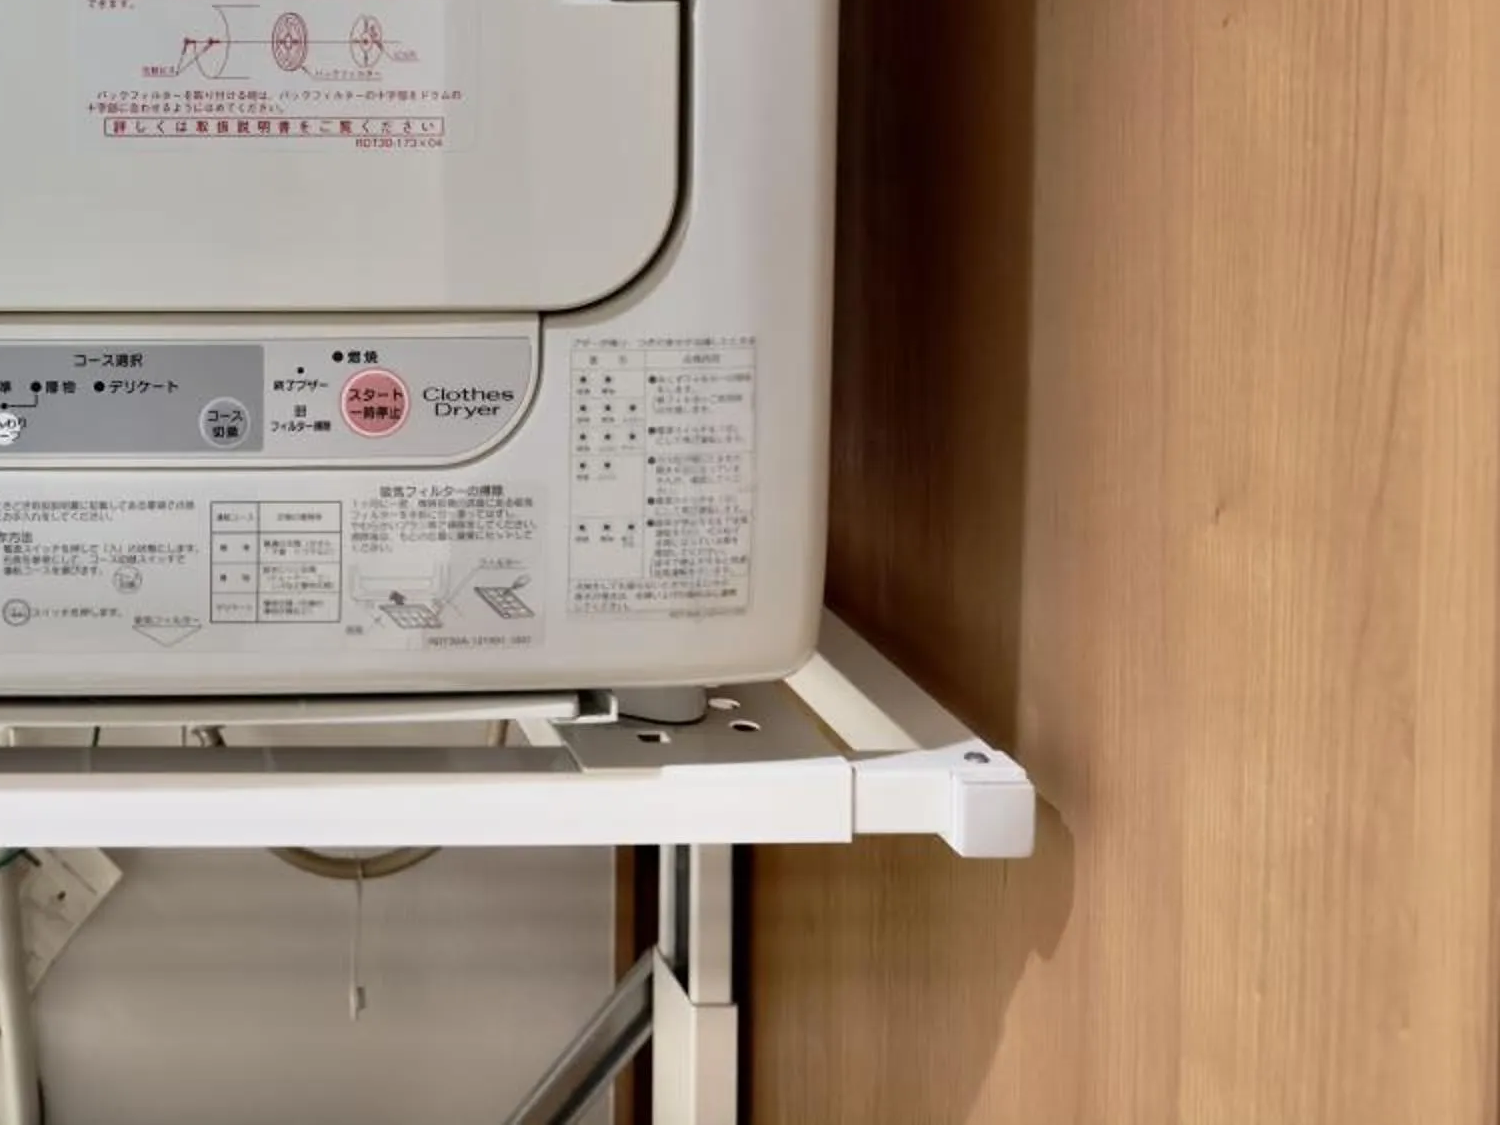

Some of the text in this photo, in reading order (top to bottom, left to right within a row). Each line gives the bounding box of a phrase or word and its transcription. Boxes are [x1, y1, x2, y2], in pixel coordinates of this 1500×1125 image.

[113, 120, 435, 134] 詳しくは取扱説明書をご覧ください
[73, 353, 144, 368] コース選択
[347, 351, 378, 364] 燃焼
[45, 380, 77, 394] 厚物
[108, 380, 179, 394] デリケート
[272, 378, 329, 392] 終了ブザー
[349, 388, 405, 402] スタート
[423, 386, 515, 402] Clothes
[206, 410, 243, 422] コース
[350, 406, 401, 420] 一時停止
[434, 402, 502, 419] Dryer
